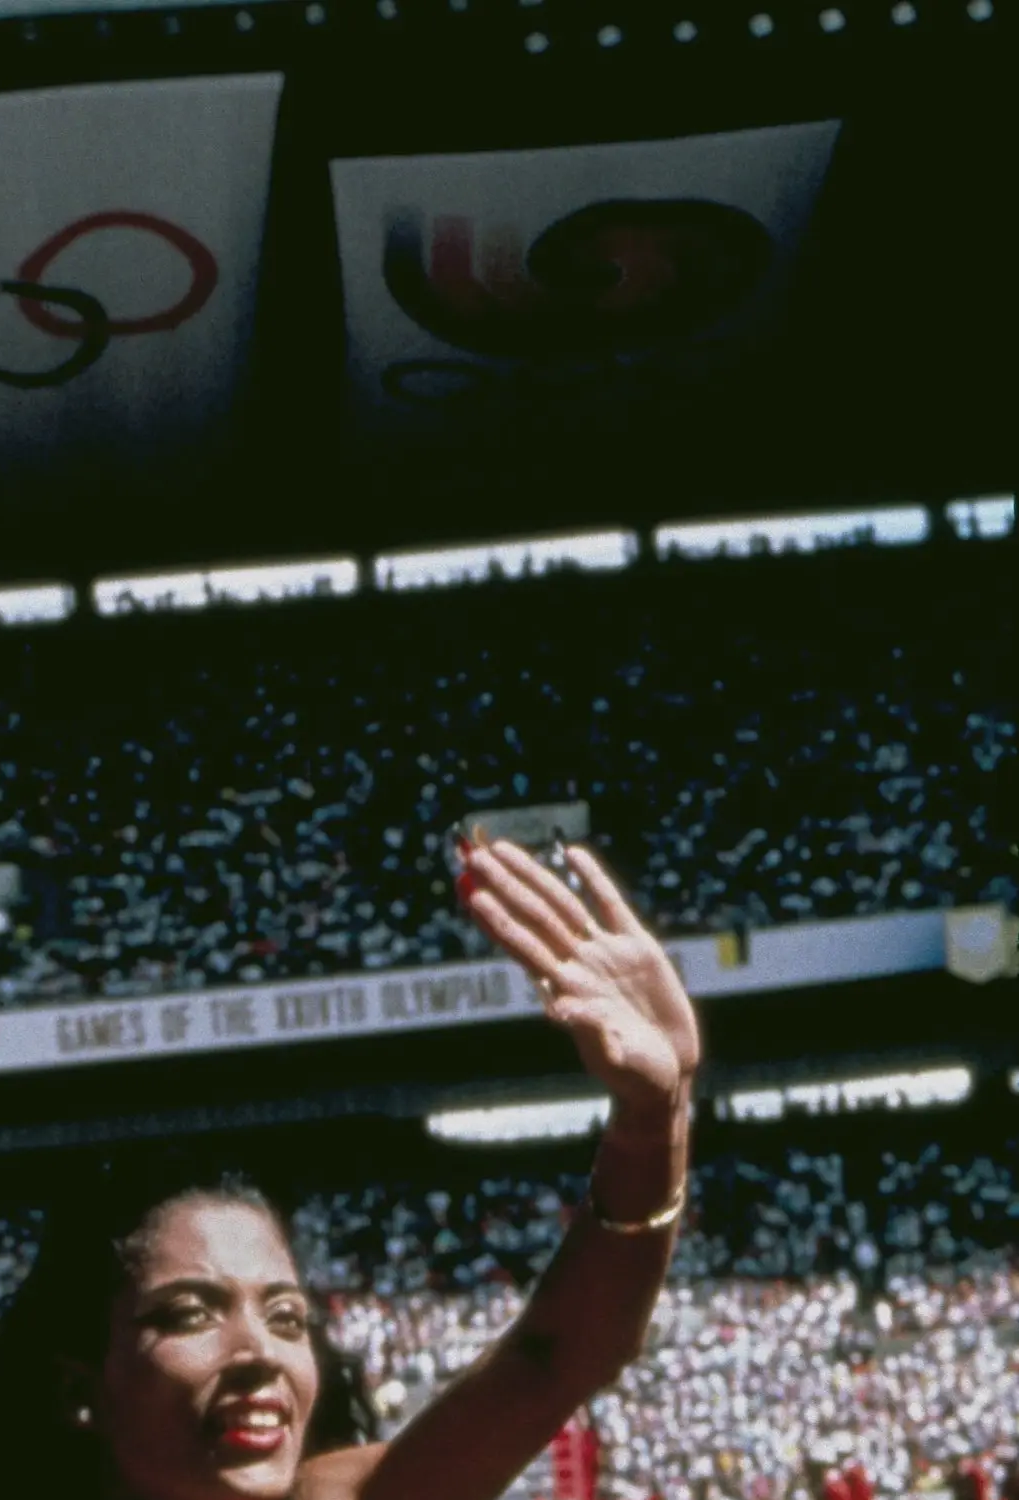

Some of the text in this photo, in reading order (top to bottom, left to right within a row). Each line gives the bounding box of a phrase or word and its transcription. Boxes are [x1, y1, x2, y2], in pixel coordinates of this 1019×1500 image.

[55, 1007, 146, 1054] GAMES
[160, 1001, 191, 1044] OF
[210, 997, 259, 1038] THE
